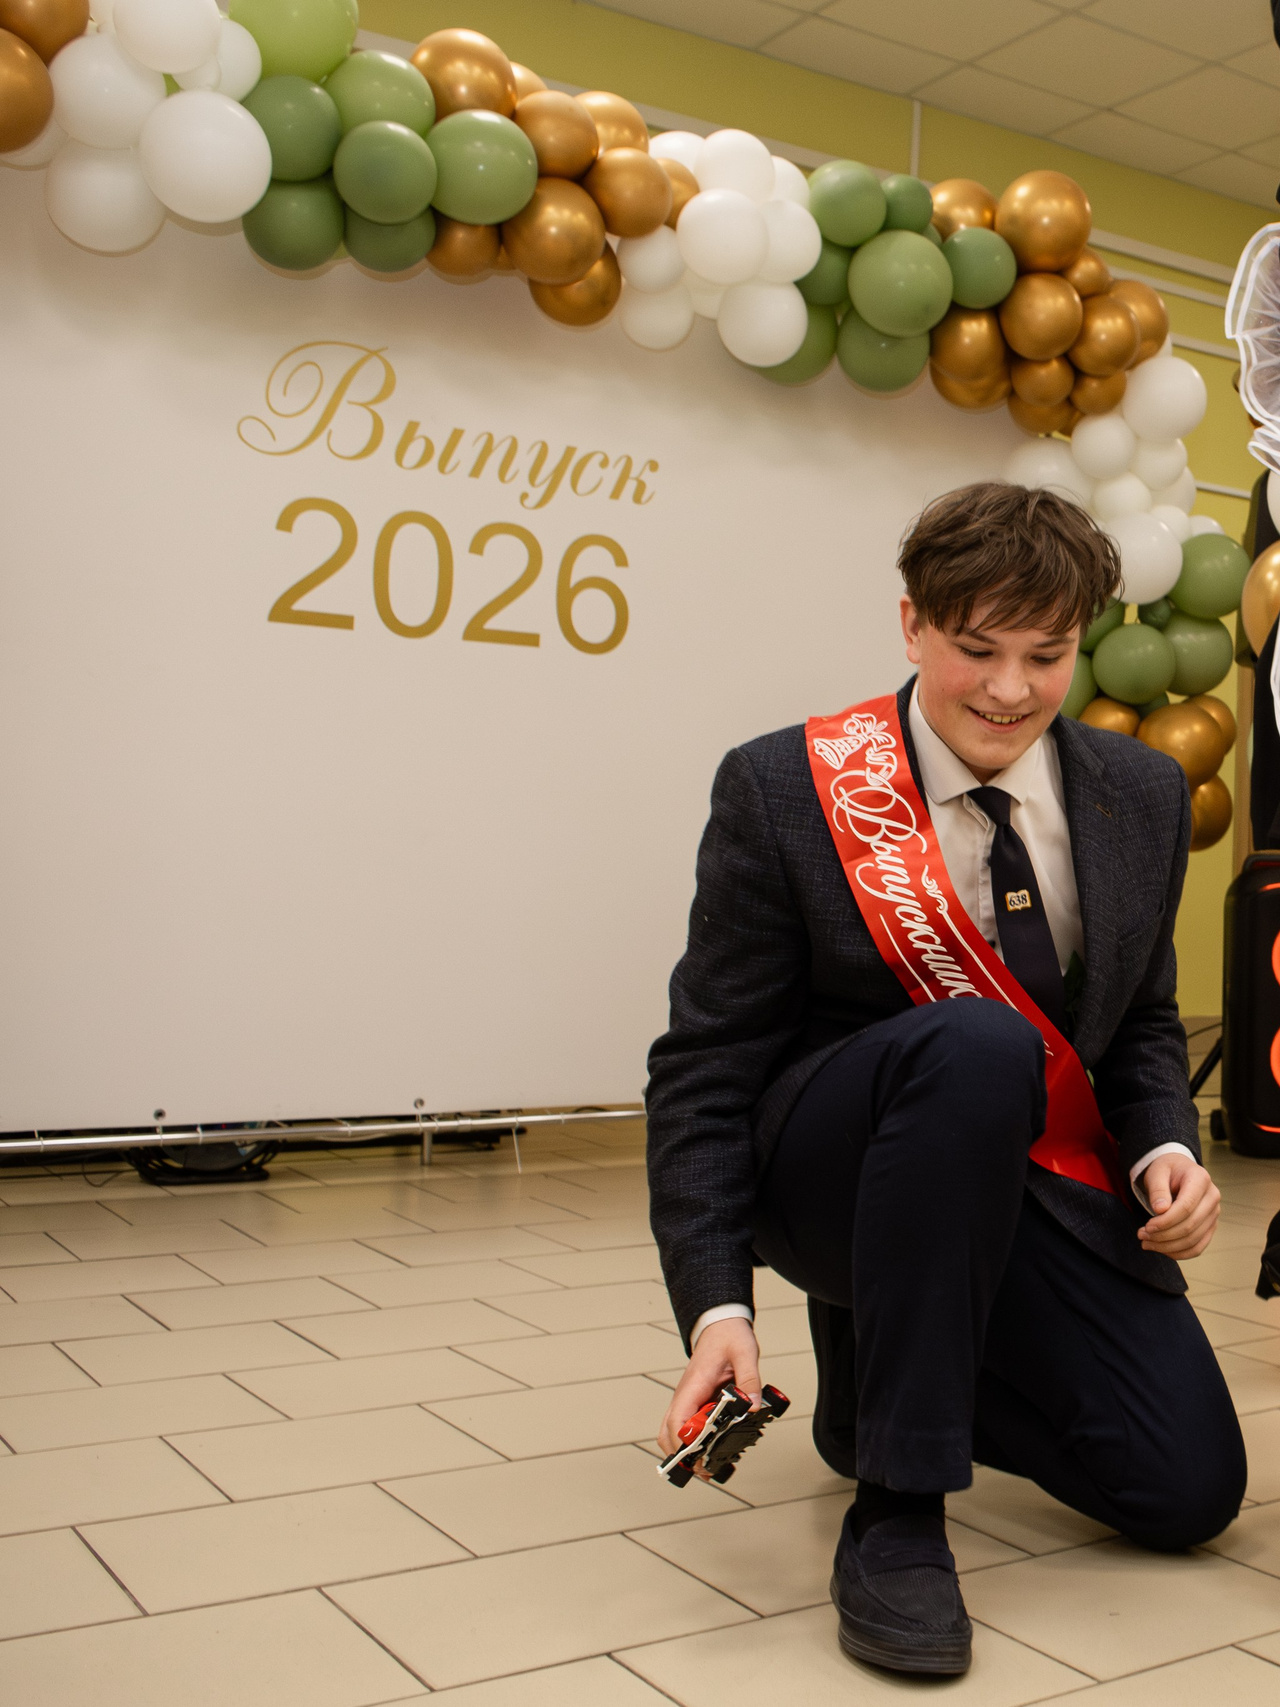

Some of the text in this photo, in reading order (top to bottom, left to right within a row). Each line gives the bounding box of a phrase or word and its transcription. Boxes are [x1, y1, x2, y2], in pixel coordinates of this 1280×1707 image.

[236, 340, 660, 511] Выпуск
[267, 496, 630, 656] 2026
[1008, 892, 1028, 907] 638
